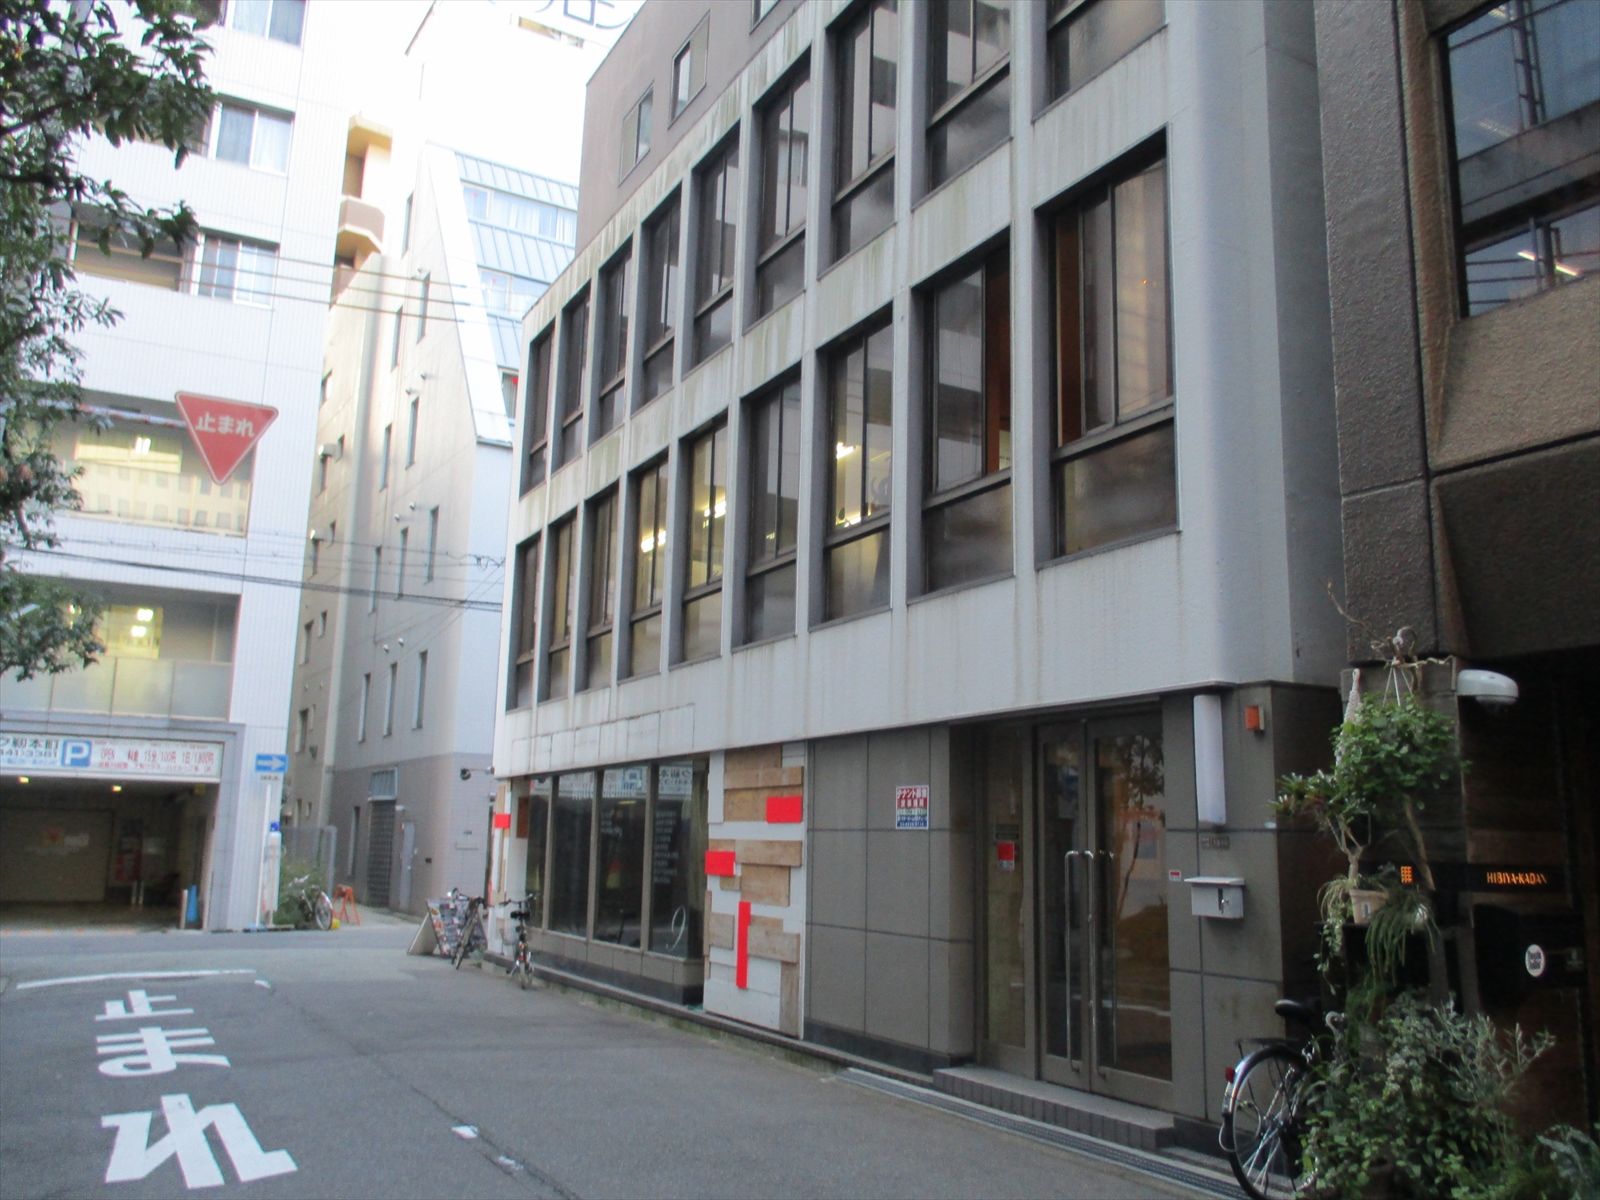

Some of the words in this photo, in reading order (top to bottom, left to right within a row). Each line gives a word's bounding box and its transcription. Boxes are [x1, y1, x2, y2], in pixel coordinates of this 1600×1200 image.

[195, 411, 255, 438] 止まれ
[64, 742, 90, 767] P
[95, 989, 298, 1189] 止まれ
